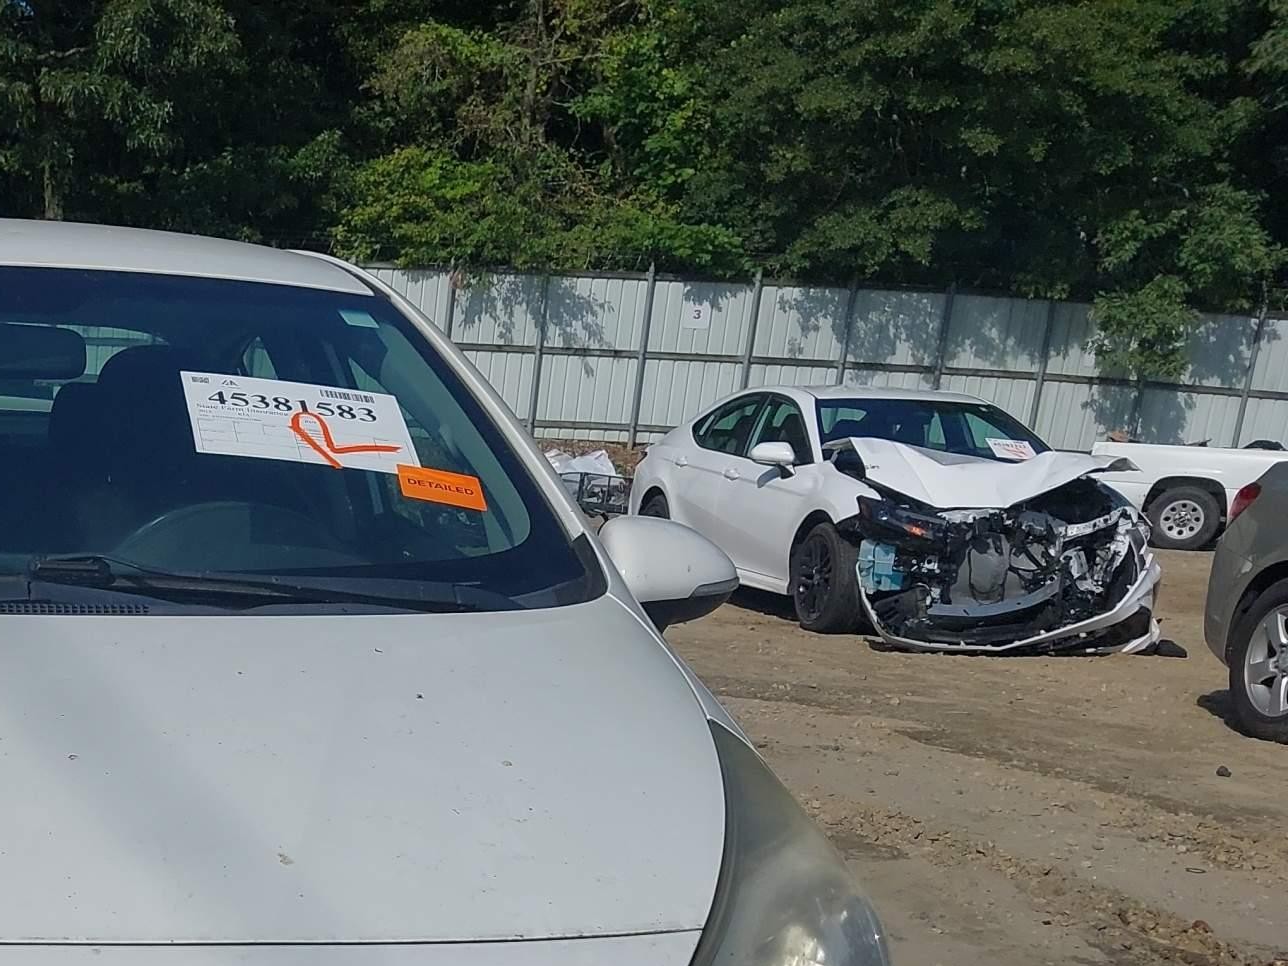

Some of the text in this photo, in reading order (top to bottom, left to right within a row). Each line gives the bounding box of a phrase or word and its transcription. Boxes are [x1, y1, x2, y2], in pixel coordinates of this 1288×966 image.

[693, 310, 701, 319] 3
[208, 391, 377, 422] 45381583
[407, 478, 474, 496] DETAILED
